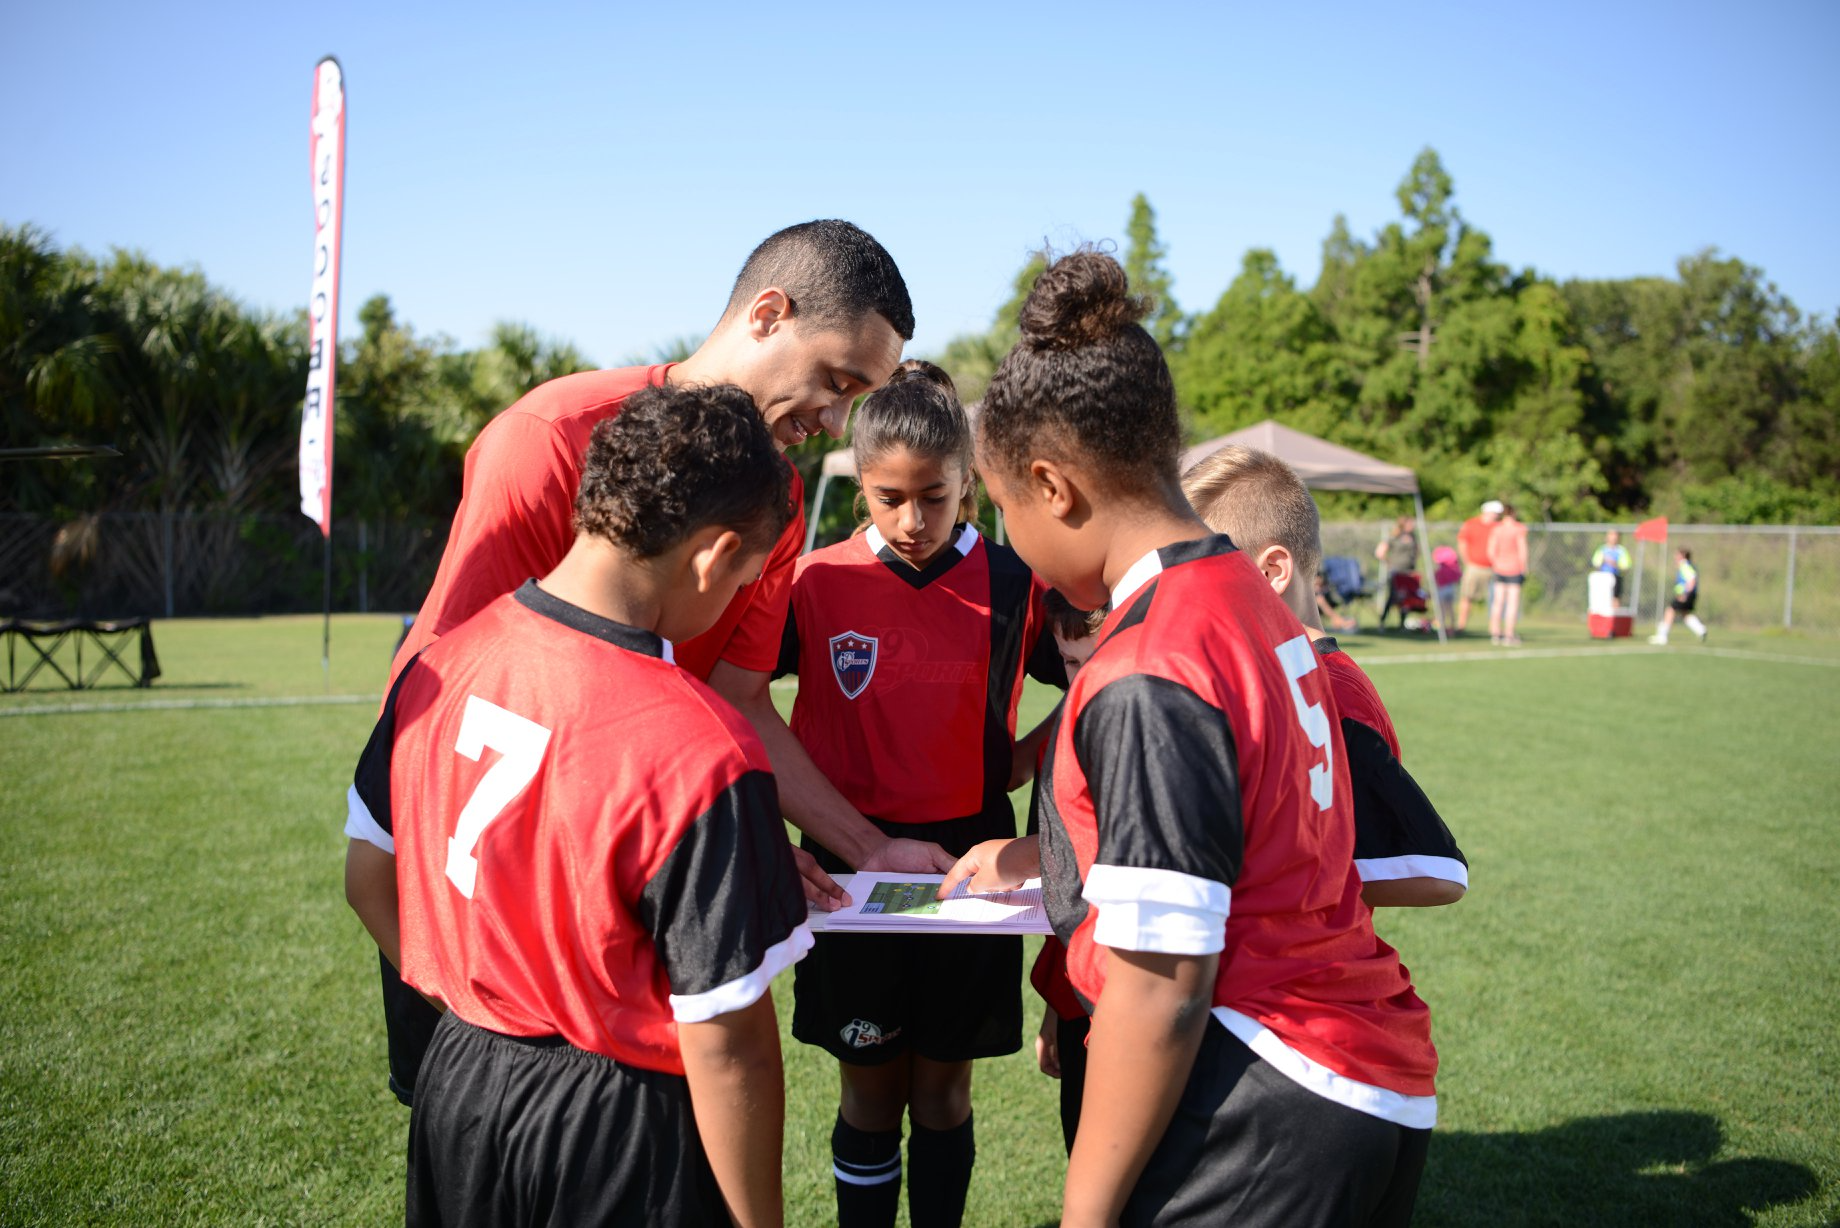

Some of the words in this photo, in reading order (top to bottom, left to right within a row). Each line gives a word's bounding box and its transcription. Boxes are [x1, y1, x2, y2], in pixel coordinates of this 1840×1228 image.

[445, 694, 552, 900] 7
[1274, 634, 1333, 812] 5
[847, 1020, 871, 1046] i9
